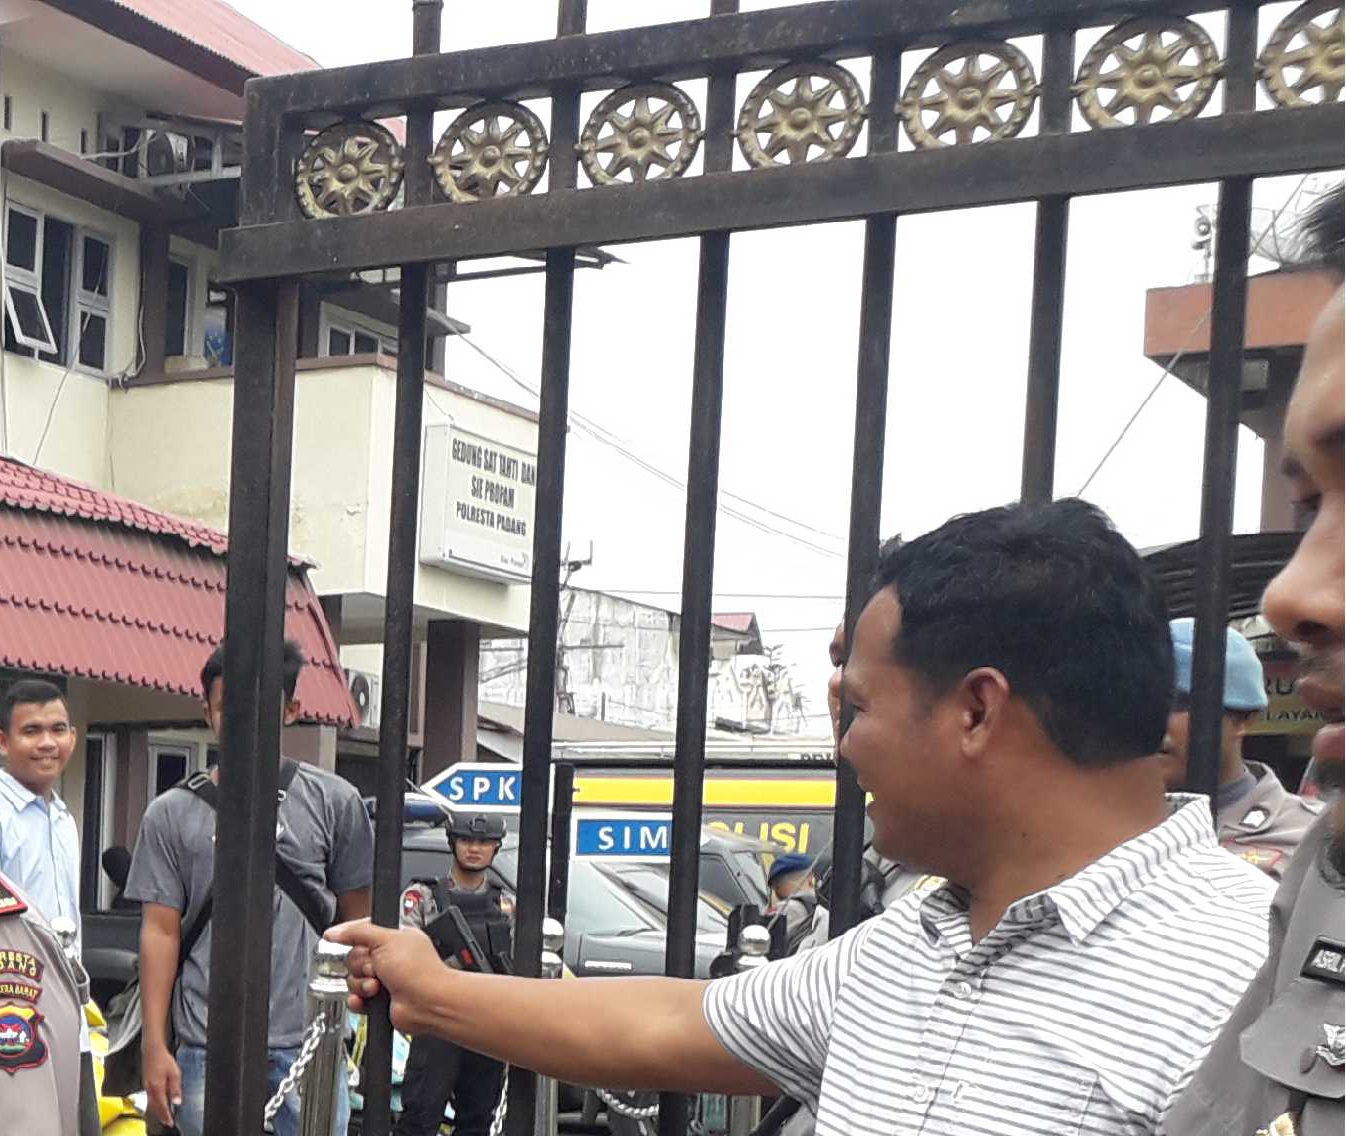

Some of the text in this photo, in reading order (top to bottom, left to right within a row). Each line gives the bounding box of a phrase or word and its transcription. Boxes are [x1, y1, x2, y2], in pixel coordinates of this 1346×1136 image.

[452, 438, 482, 469] GEDUNG
[456, 501, 527, 536] POLRESTA PADANG
[598, 826, 669, 850] SIM
